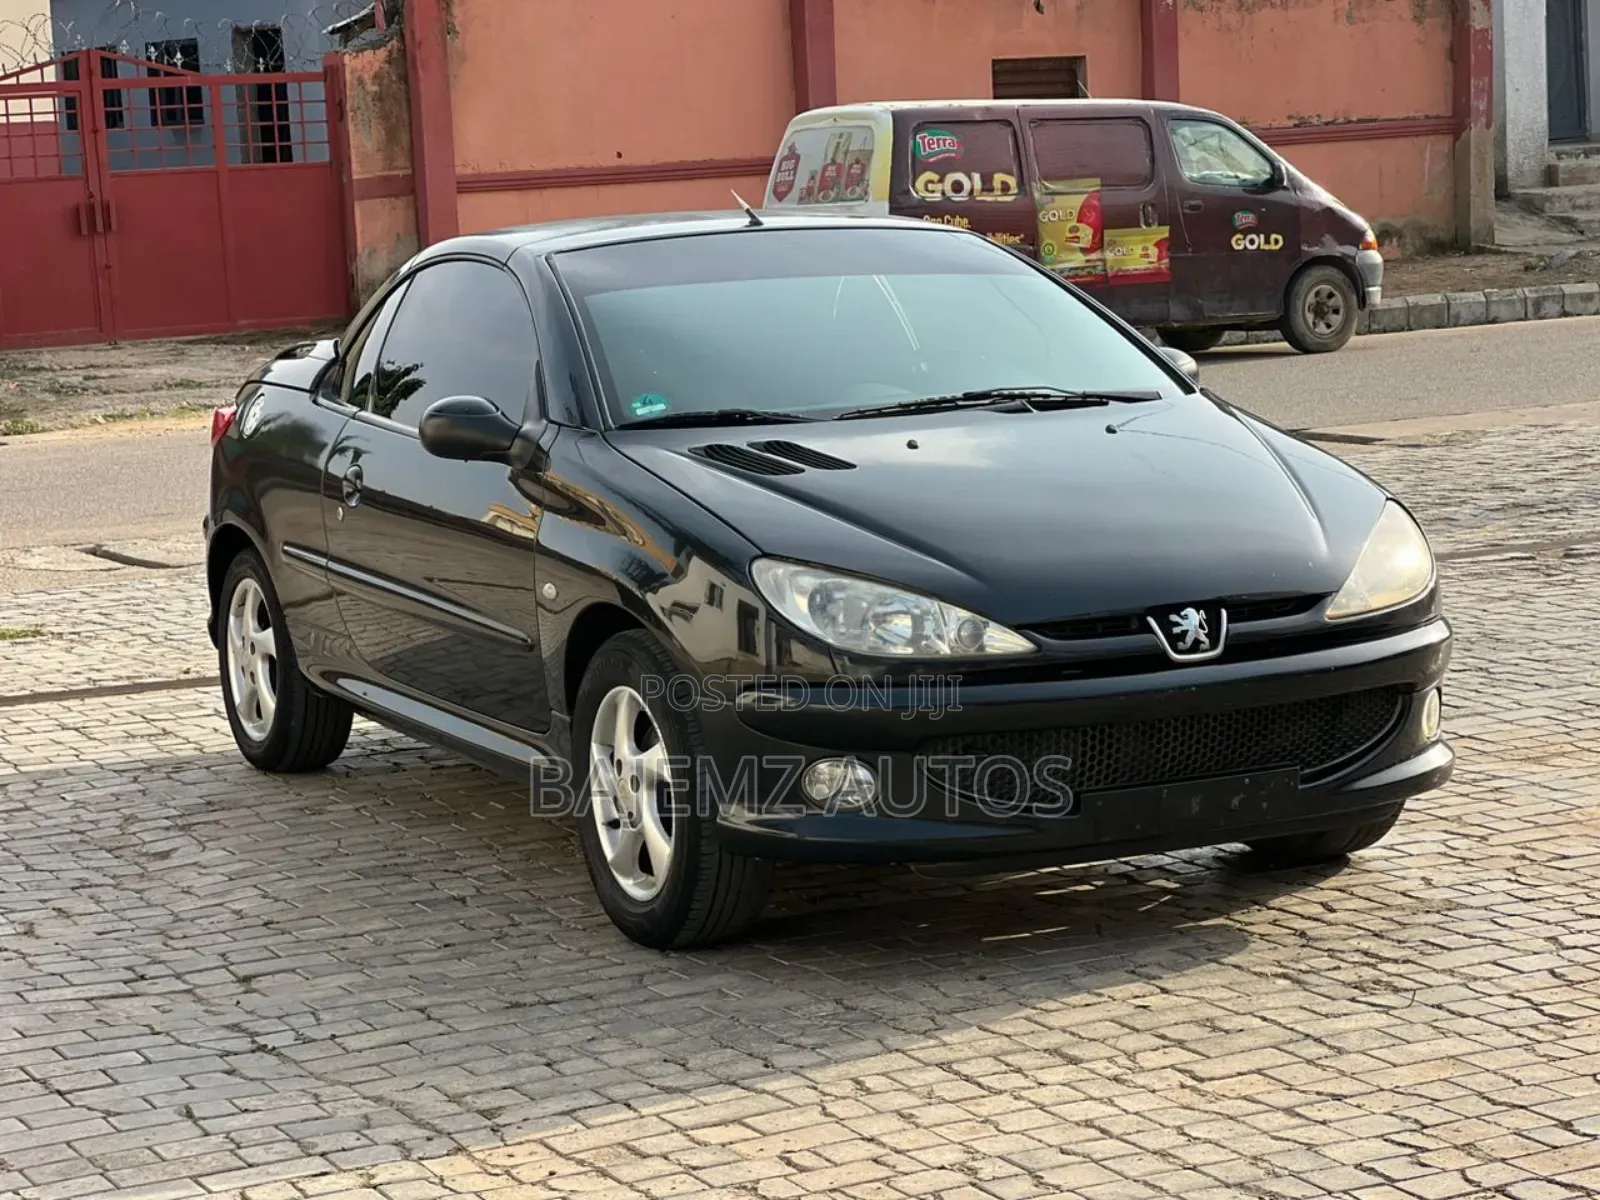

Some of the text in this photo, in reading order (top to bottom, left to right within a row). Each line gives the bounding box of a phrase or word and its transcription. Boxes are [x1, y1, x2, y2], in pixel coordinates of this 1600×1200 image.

[916, 134, 957, 155] Terra
[781, 160, 796, 171] BIG
[915, 171, 1018, 202] GOLD
[1039, 209, 1076, 222] GOLD
[1230, 233, 1284, 250] GOLD
